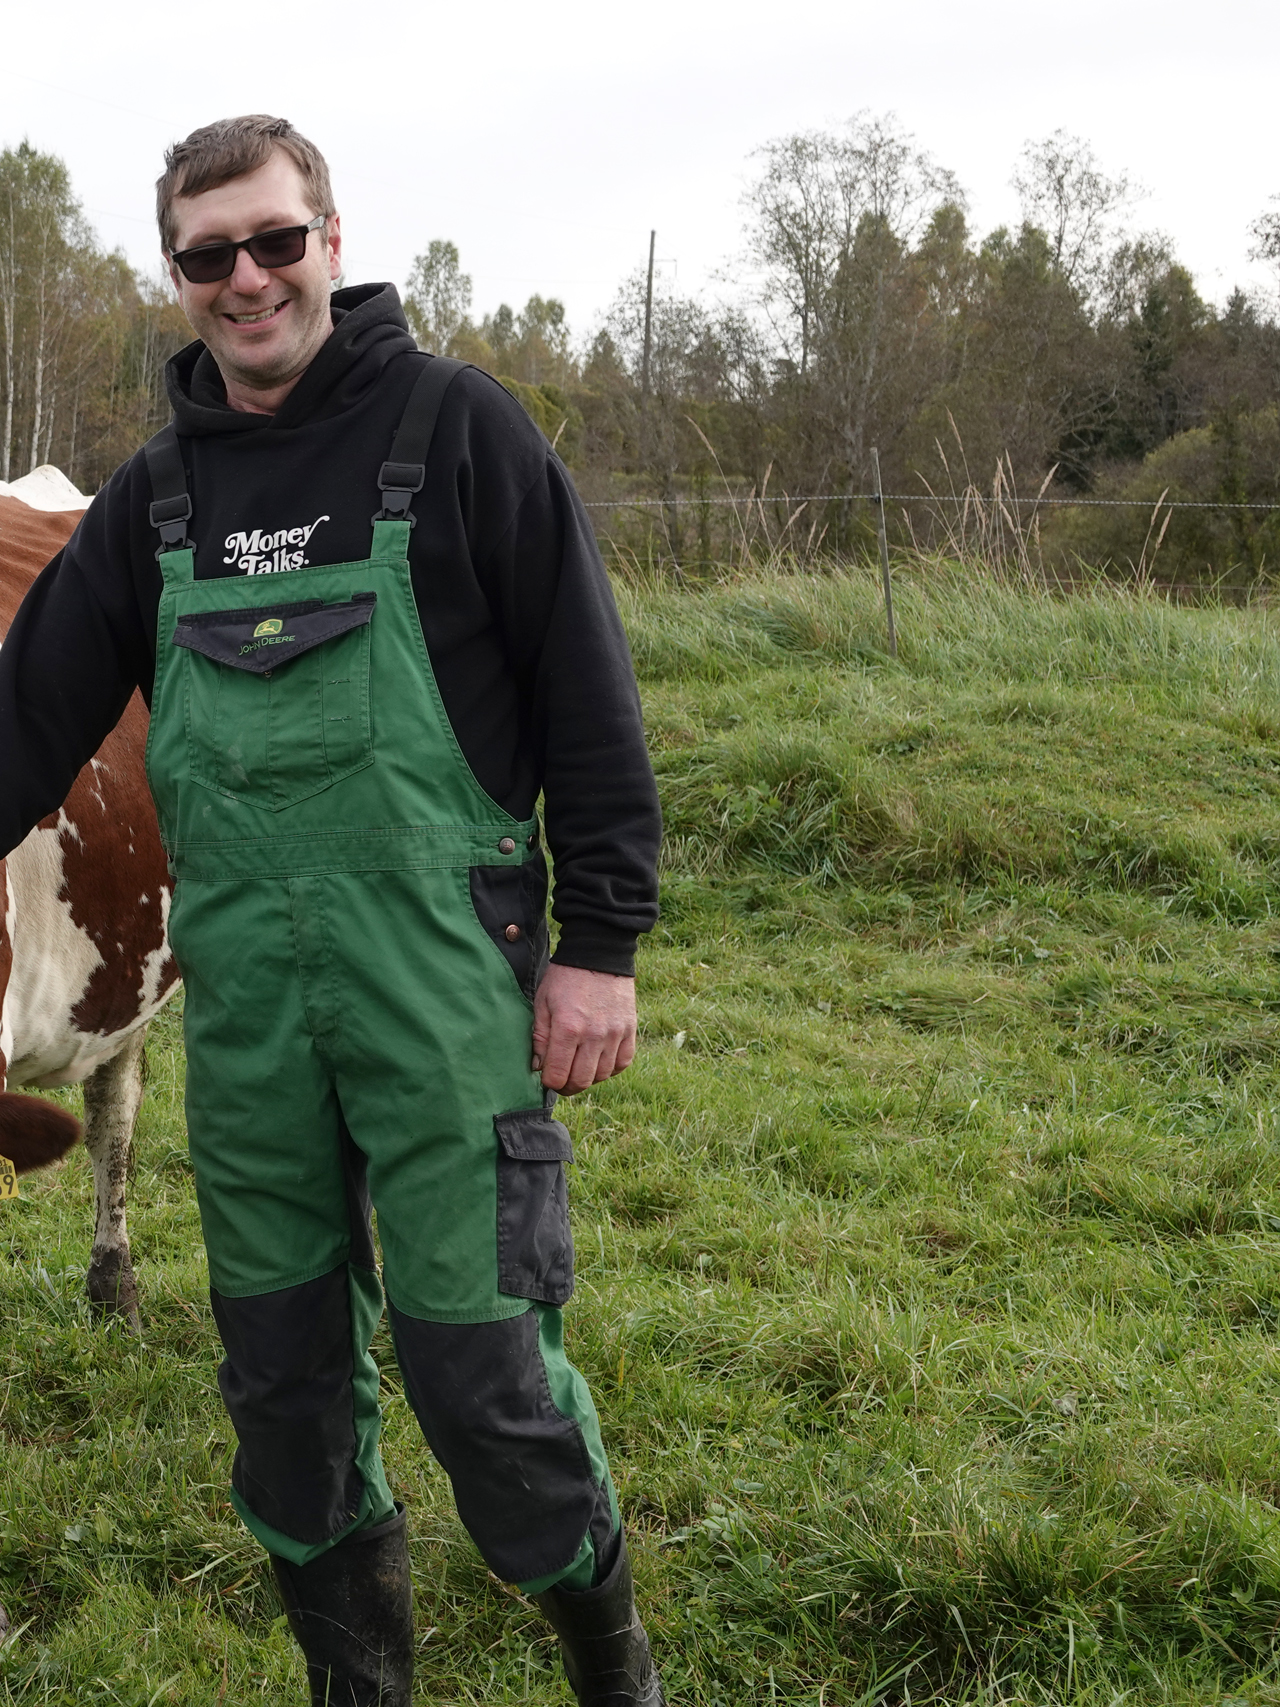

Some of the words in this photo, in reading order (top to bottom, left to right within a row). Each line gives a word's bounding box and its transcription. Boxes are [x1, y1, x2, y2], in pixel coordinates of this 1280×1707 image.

[223, 515, 330, 564] Money
[238, 640, 261, 656] JOHN
[261, 635, 296, 646] DEERE
